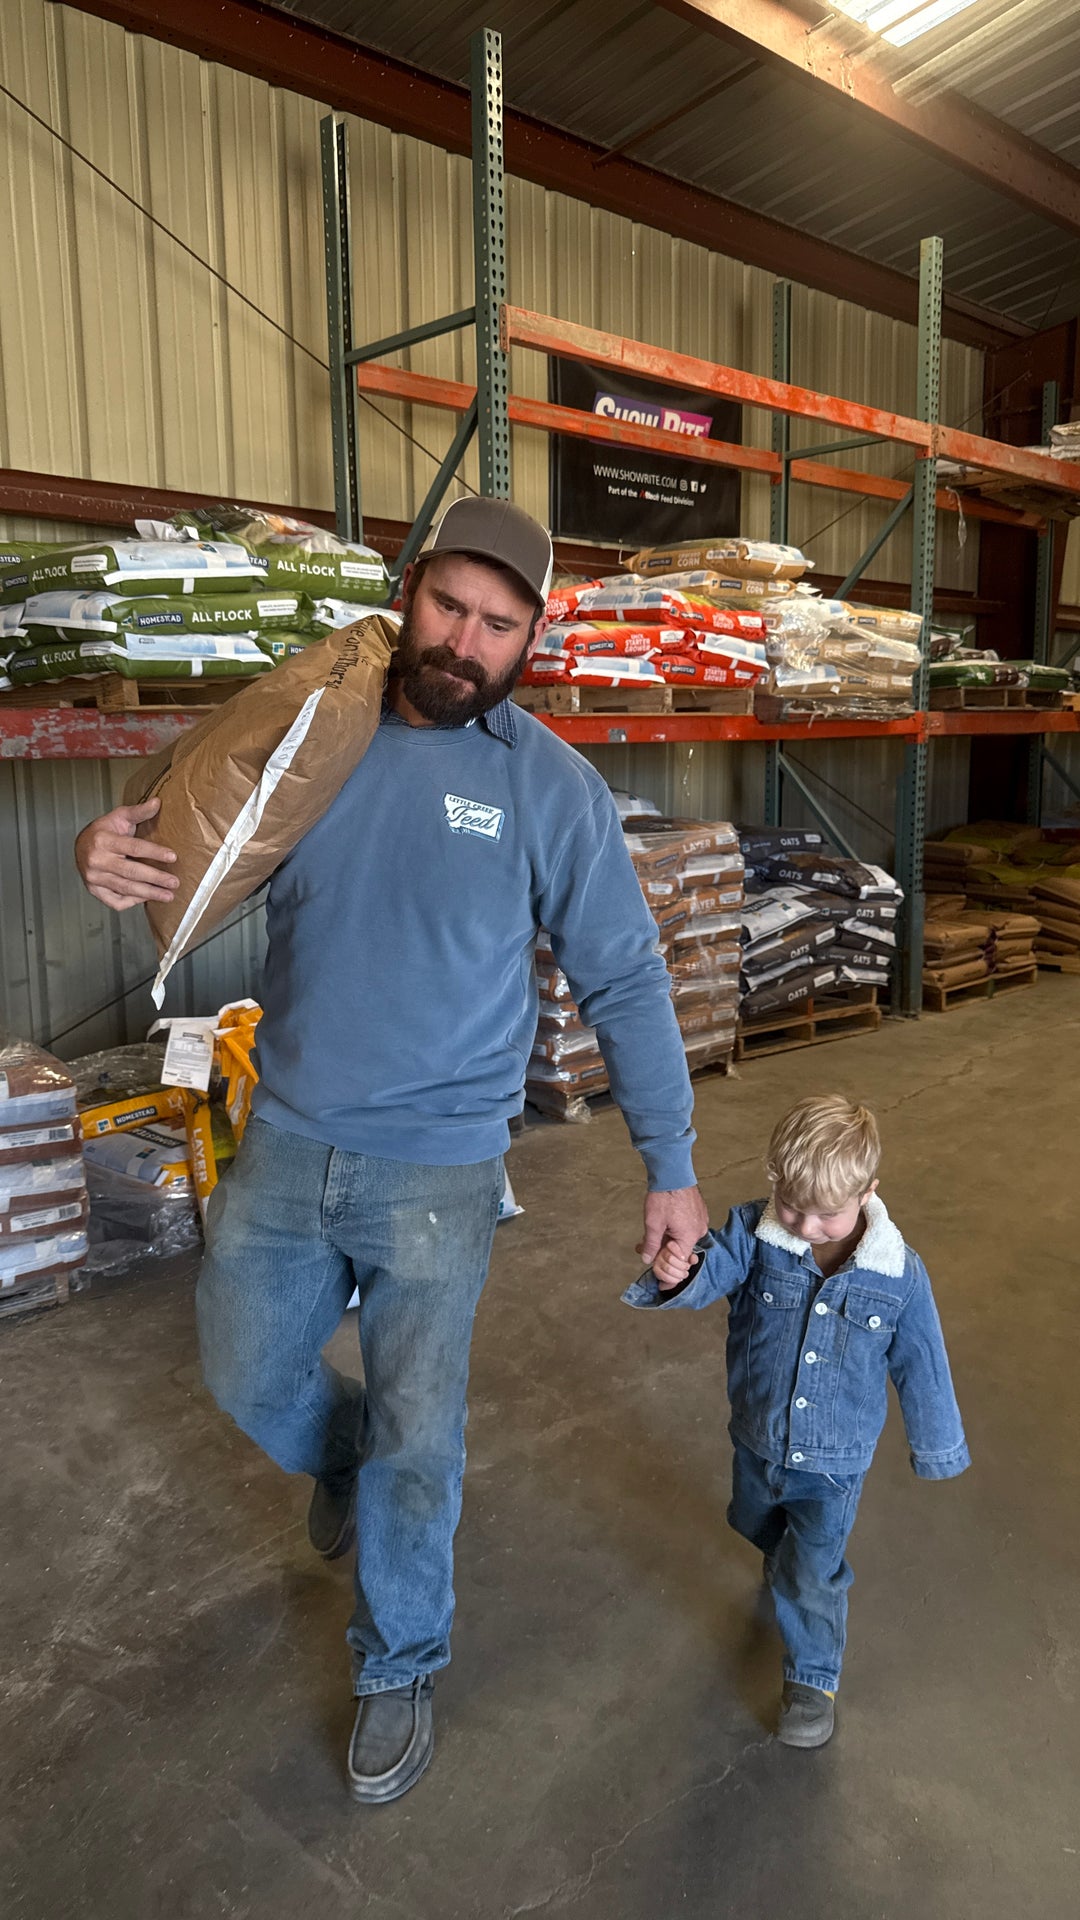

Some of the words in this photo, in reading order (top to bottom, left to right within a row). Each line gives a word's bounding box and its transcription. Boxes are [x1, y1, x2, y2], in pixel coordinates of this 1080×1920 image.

[593, 464, 678, 490] WWW.SHOWRITE.COM
[608, 485, 620, 496] Part
[628, 489, 638, 499] the
[277, 560, 298, 573] ALL
[300, 563, 336, 577] FLOCK
[678, 557, 700, 567] CORN
[140, 612, 182, 626] HOMESTEAD
[191, 611, 212, 623] ALL
[214, 609, 253, 622] FLOCK
[449, 796, 471, 806] LITTLE
[472, 803, 495, 814] CREEK
[450, 805, 503, 830] Feed
[682, 838, 711, 854] LAYER
[780, 837, 801, 847] OATS
[778, 869, 803, 881] OATS
[856, 908, 876, 919] OATS
[790, 944, 810, 959] OATS
[852, 954, 872, 965] OATS
[787, 986, 809, 1002] OATS
[115, 1107, 156, 1124] HOMESTEAD
[193, 1127, 208, 1183] LAYER
